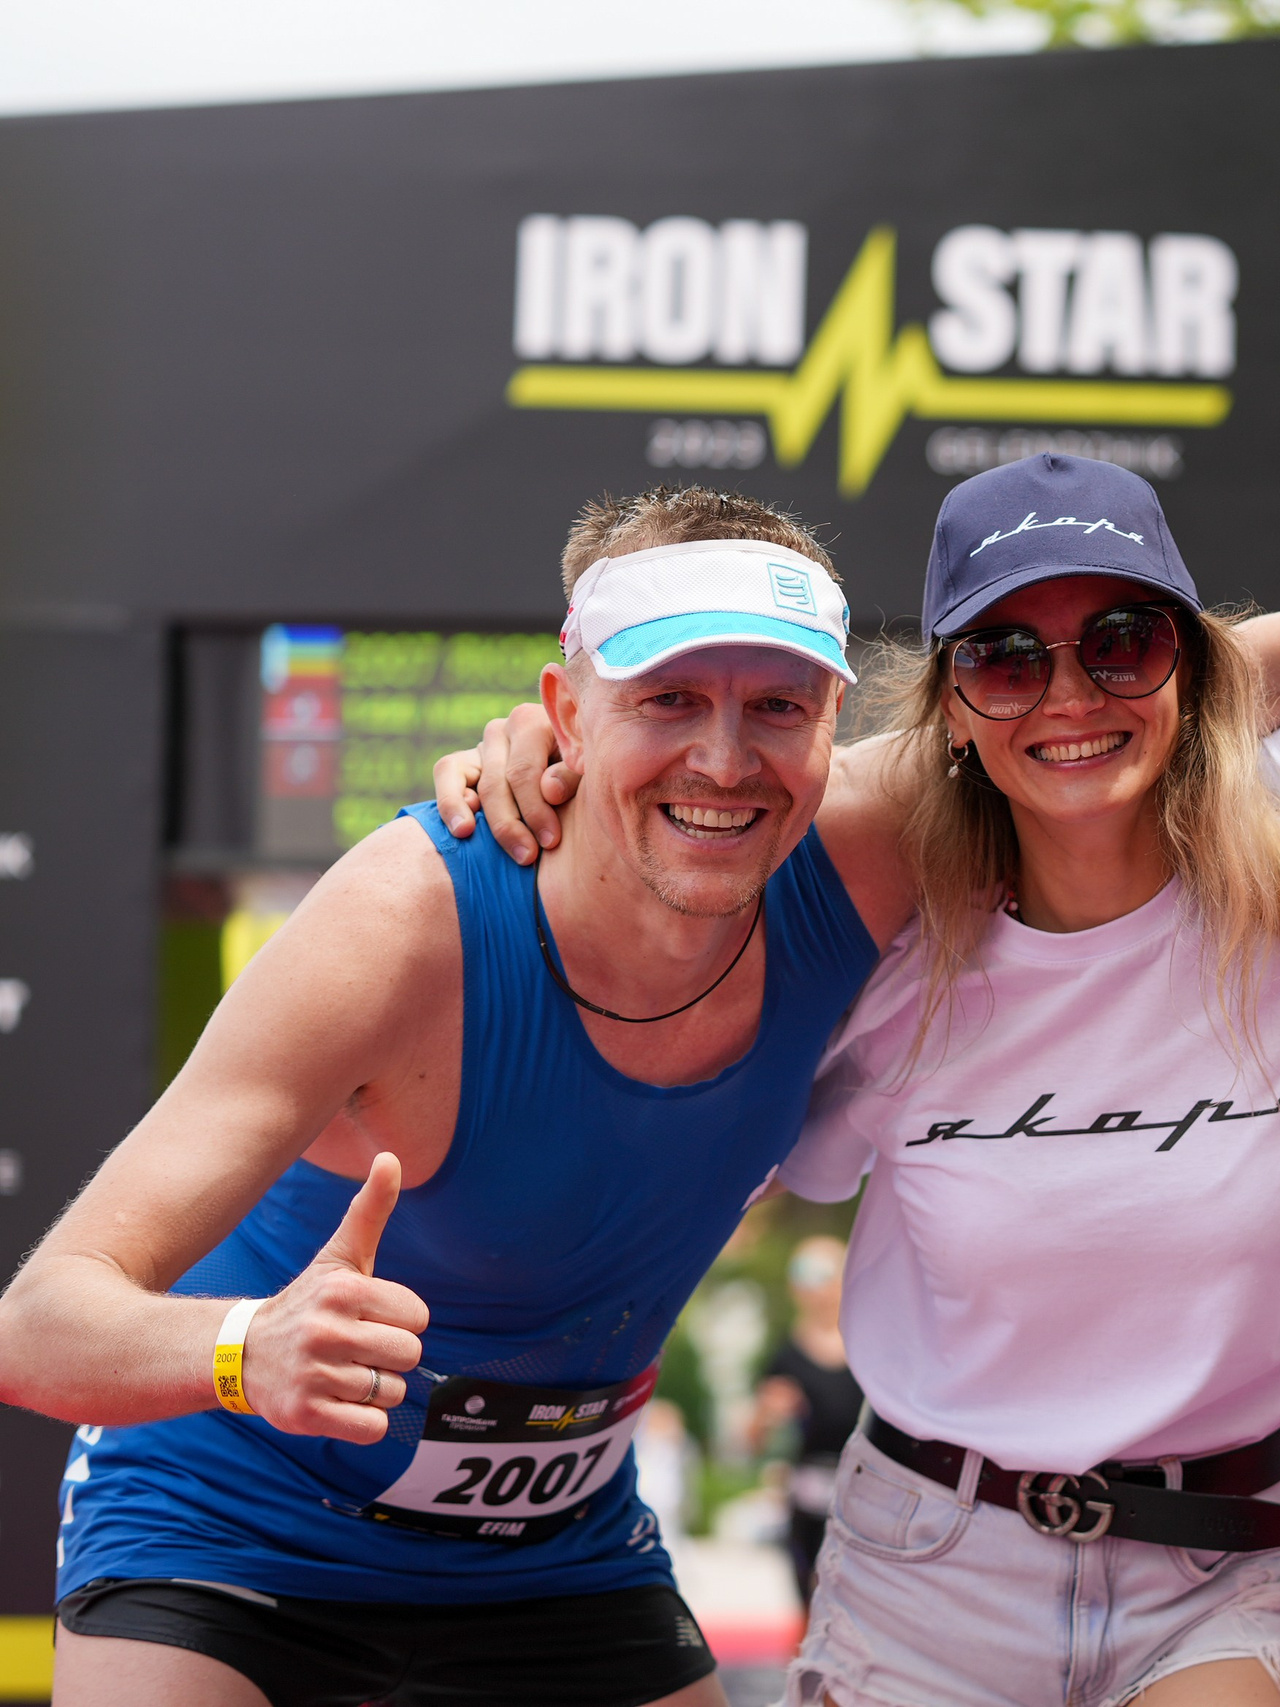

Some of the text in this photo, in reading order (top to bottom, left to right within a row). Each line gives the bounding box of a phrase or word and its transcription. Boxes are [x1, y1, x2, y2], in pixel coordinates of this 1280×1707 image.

[514, 213, 1240, 378] IRON STAR
[216, 1353, 237, 1363] 2007
[528, 1399, 609, 1421] IRON STAR
[432, 1437, 612, 1506] 2007
[477, 1521, 528, 1538] EFIM
